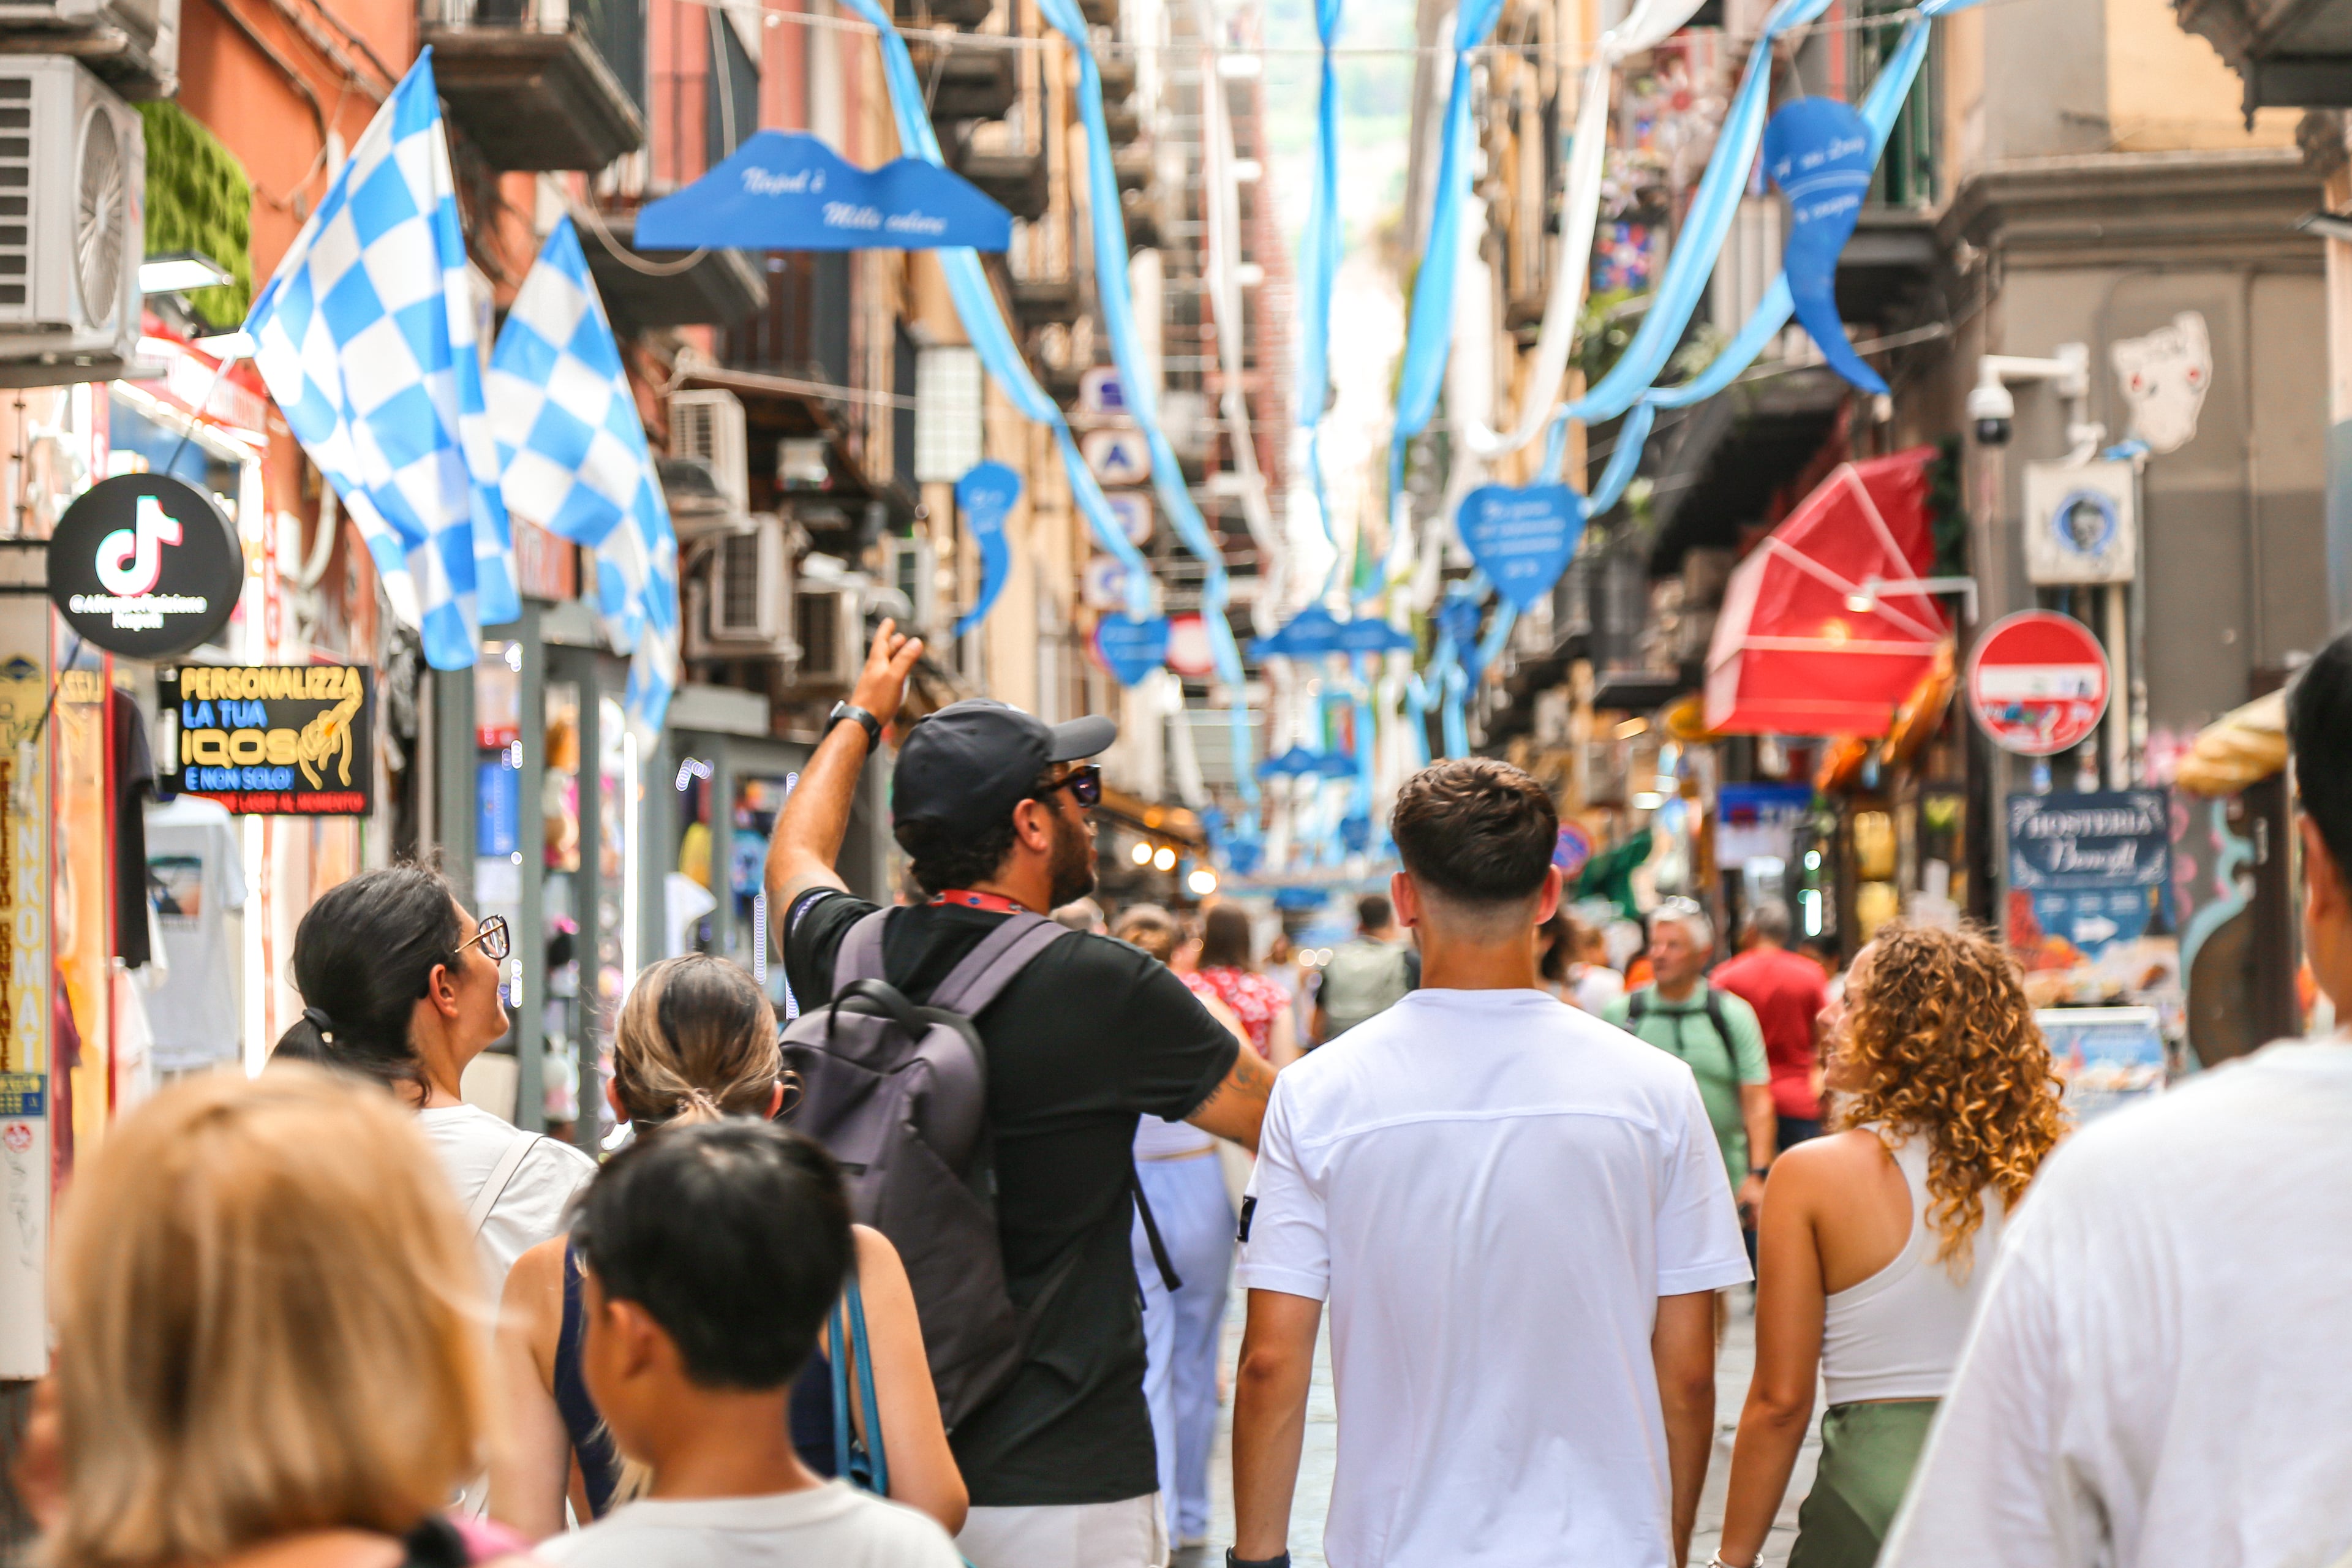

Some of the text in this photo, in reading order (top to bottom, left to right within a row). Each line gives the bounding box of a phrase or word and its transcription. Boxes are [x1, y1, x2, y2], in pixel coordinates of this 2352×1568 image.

[181, 666, 363, 700] PERSONALIZZA
[183, 700, 268, 728] LA TUA
[182, 728, 300, 769] IQOS
[186, 767, 200, 790] E
[200, 767, 241, 790] NON
